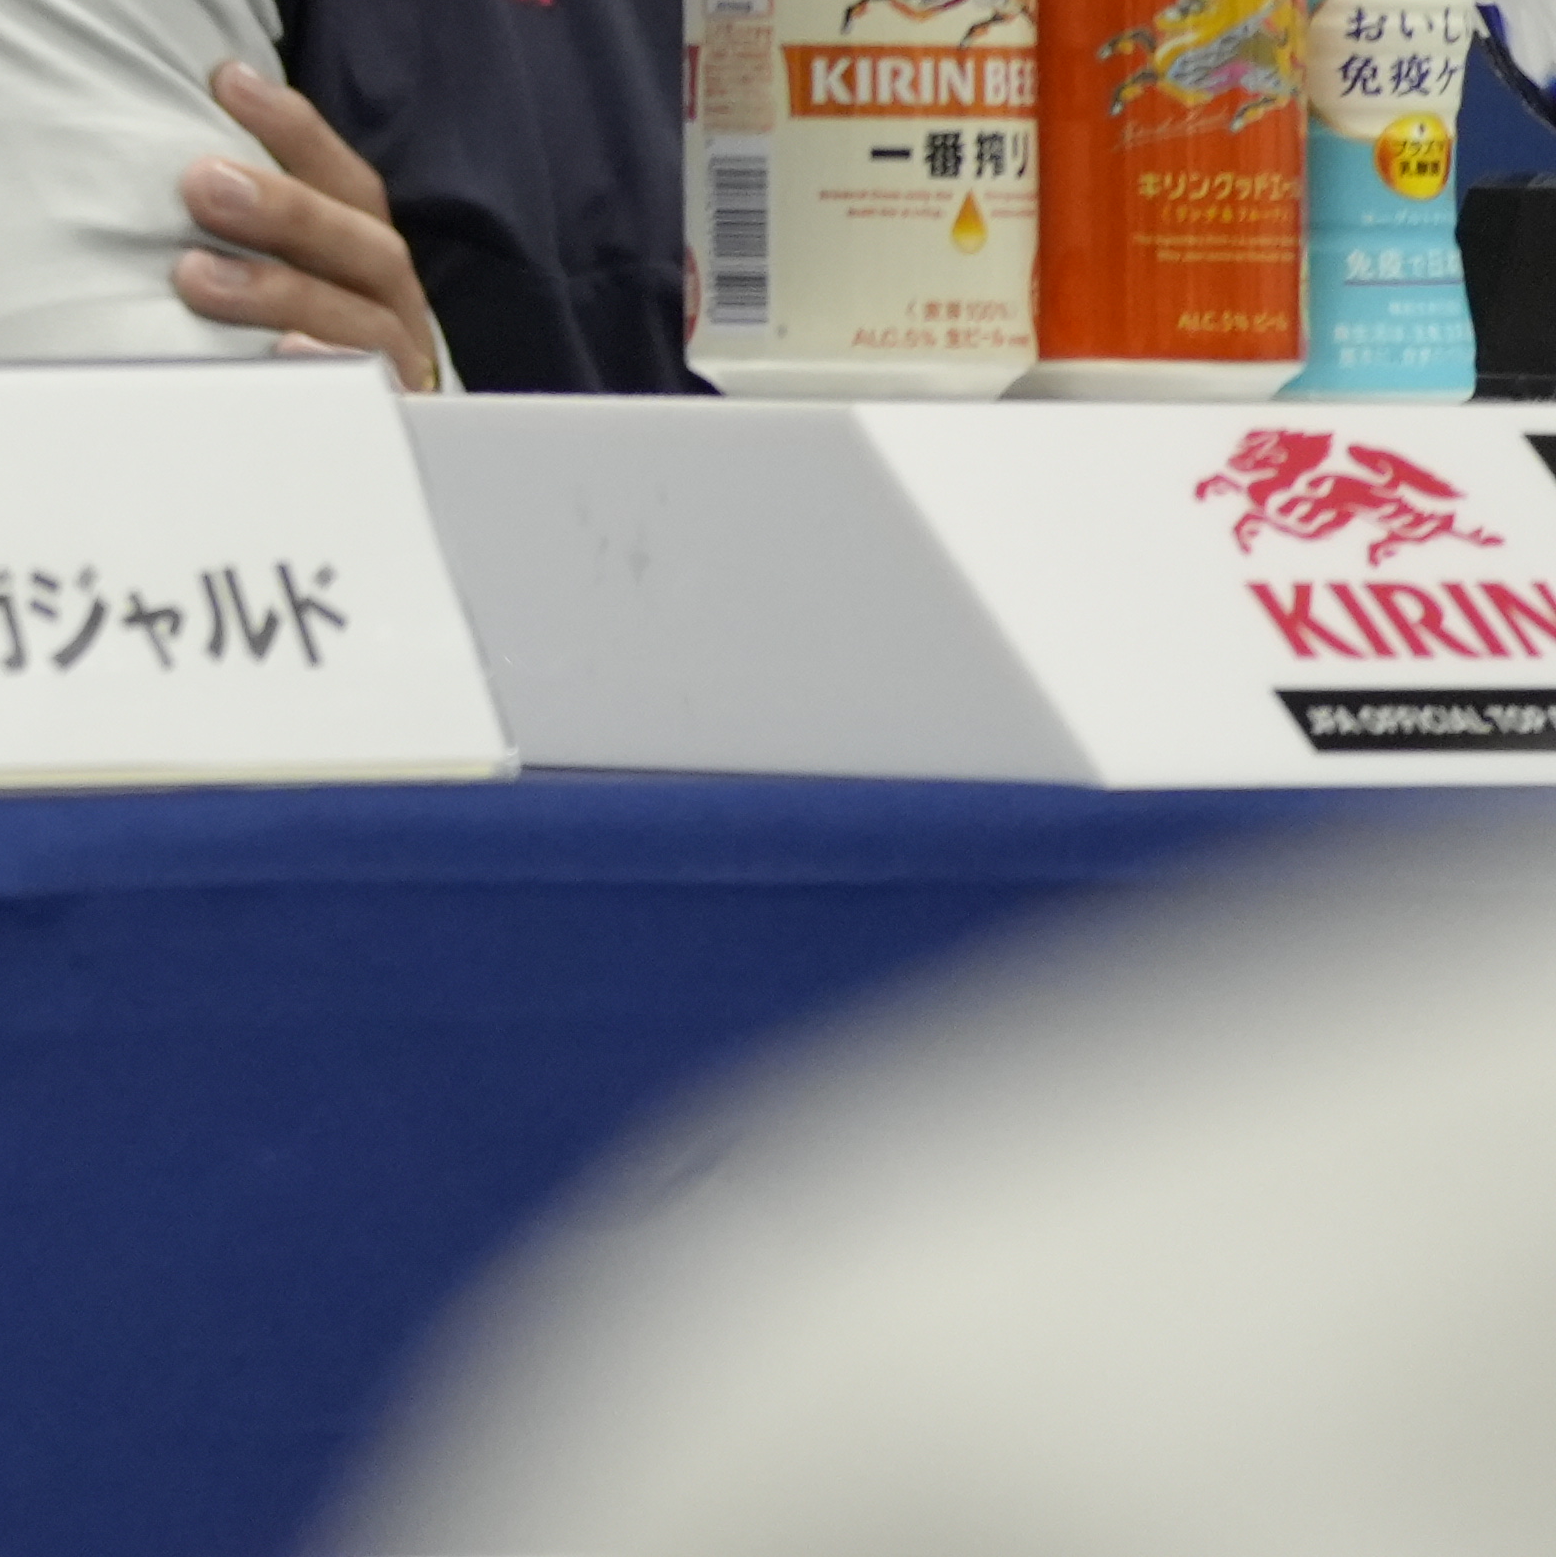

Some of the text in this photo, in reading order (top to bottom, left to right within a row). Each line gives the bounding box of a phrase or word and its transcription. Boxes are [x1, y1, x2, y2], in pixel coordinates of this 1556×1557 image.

[808, 56, 976, 106] KIRIN
[870, 131, 1029, 179] 一番搾り
